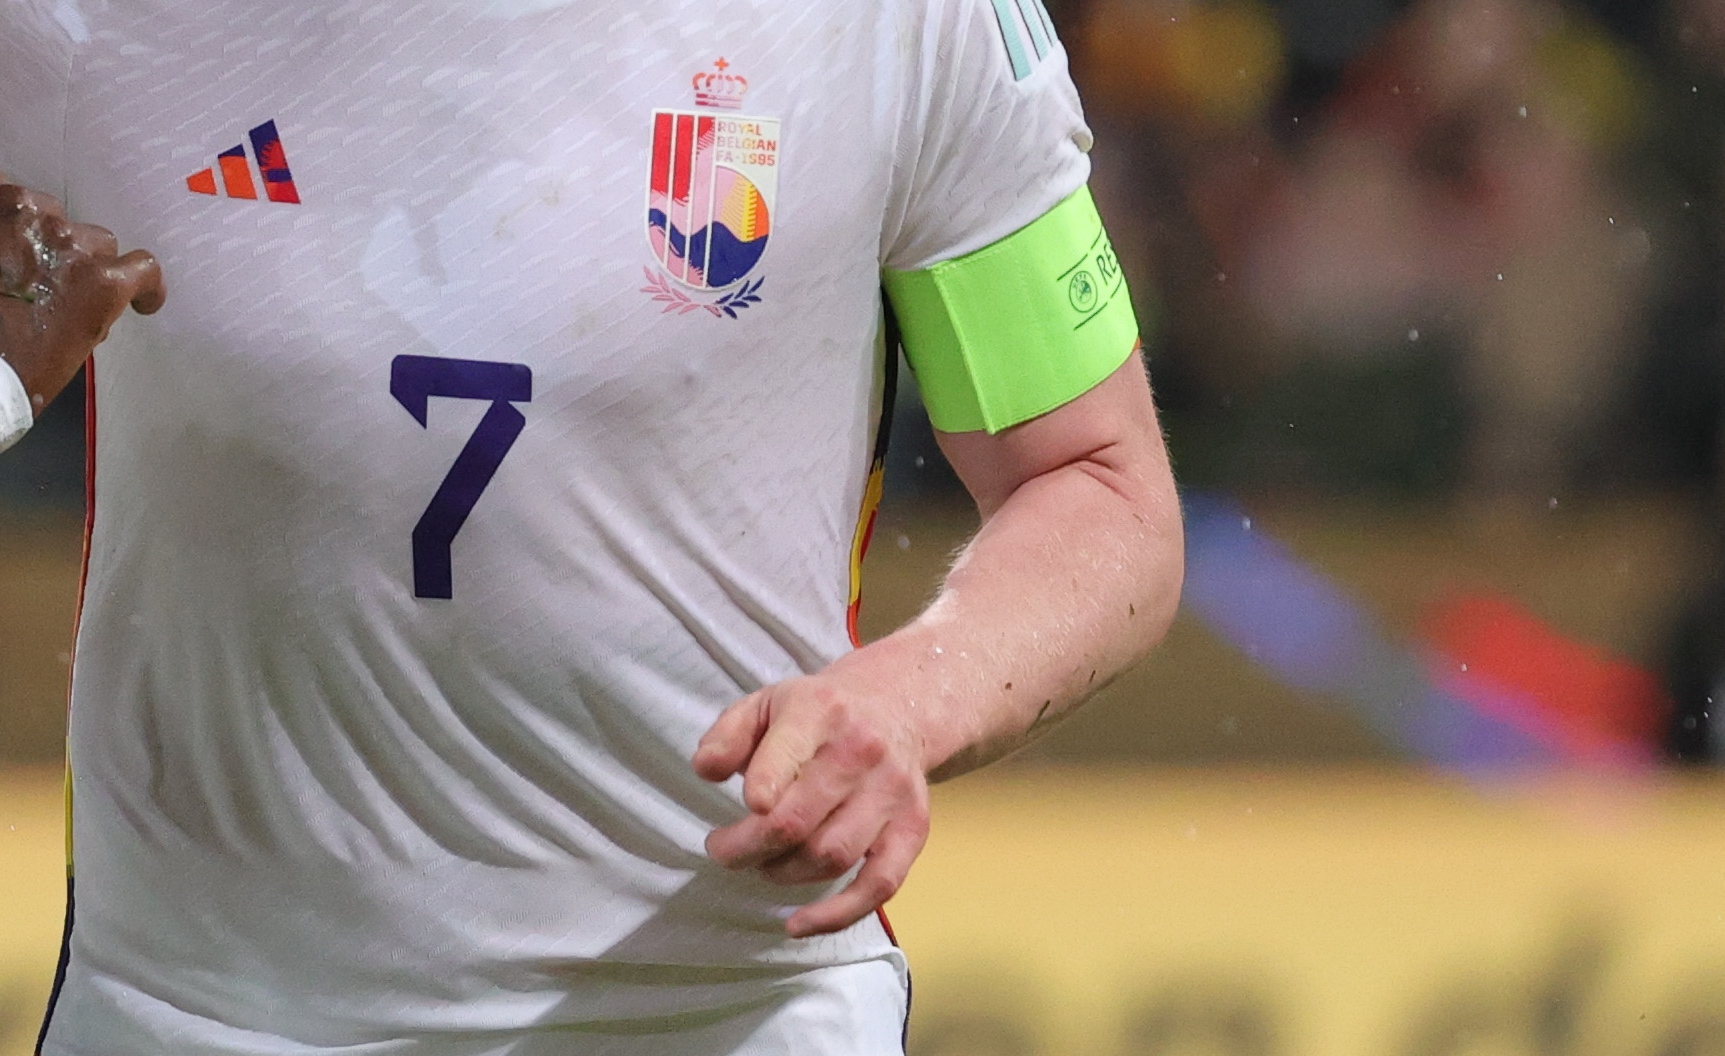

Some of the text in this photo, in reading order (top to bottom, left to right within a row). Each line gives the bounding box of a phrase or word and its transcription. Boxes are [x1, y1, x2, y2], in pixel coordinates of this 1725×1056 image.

[717, 120, 762, 136] ROYAL
[716, 135, 777, 152] BELGIAN
[390, 354, 532, 599] 7
